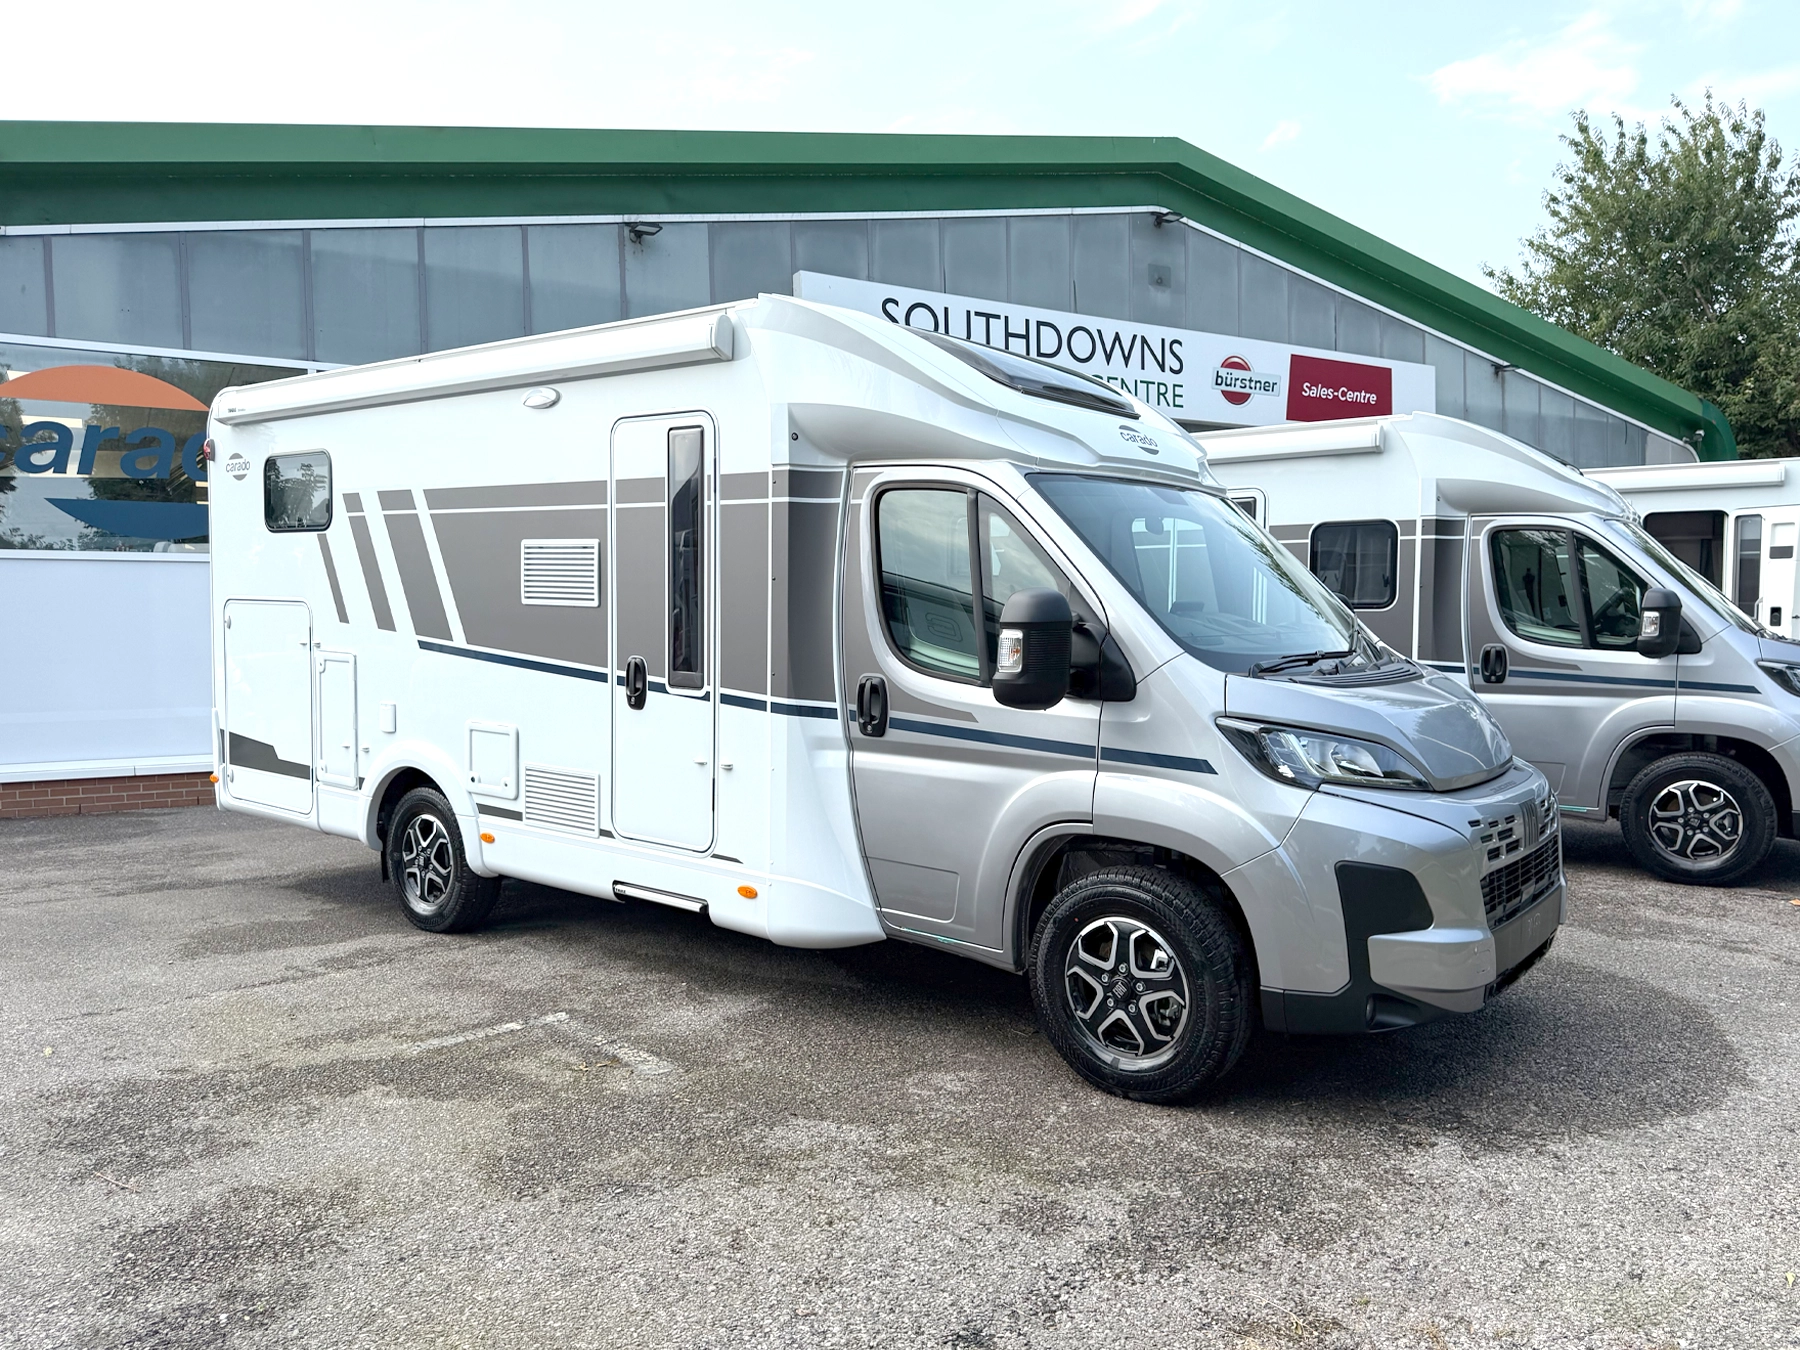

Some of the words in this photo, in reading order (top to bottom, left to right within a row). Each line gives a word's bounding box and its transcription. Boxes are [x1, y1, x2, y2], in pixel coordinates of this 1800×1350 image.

[881, 297, 1184, 375] SOUTHDOWNS
[1092, 374, 1184, 408] NTRE
[1215, 371, 1278, 393] bürstner
[1302, 382, 1377, 405] Sales-Centre
[1120, 431, 1158, 447] carado
[225, 459, 251, 473] carado
